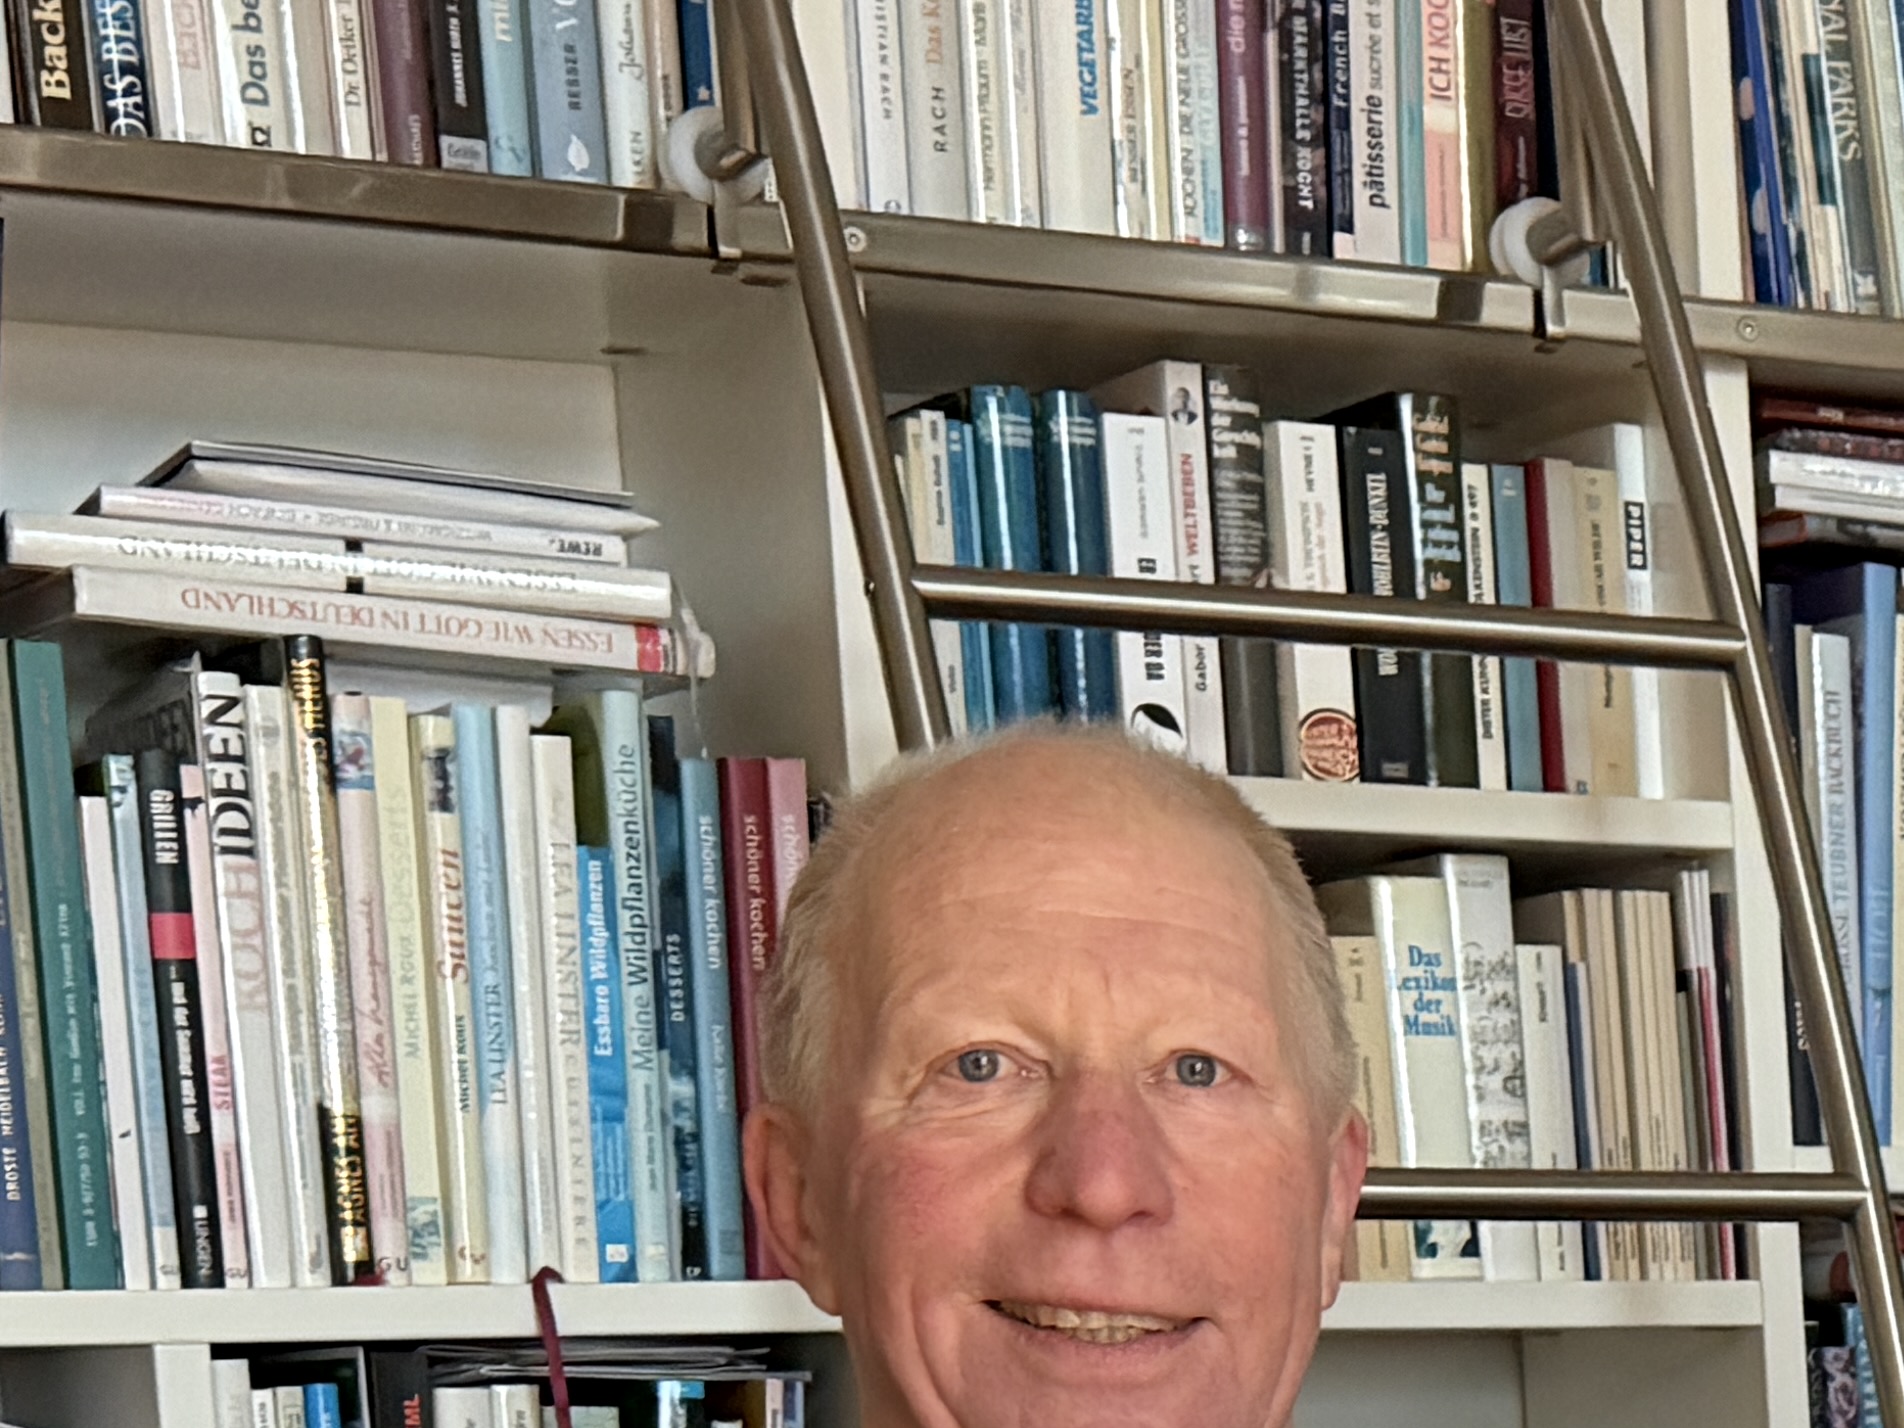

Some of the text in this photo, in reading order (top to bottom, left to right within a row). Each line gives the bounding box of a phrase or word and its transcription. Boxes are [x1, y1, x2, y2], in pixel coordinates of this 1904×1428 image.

[239, 45, 271, 107] Das
[1427, 56, 1454, 101] ICH
[930, 86, 950, 154] RACH
[1828, 60, 1861, 160] PARKS
[1359, 93, 1392, 210] pâtisserie
[1625, 504, 1645, 569] PIPER
[180, 587, 374, 629] DEUTSCHLAND
[380, 610, 410, 635] IN
[416, 612, 483, 640] GOTT
[541, 627, 613, 653] ESSEN
[1195, 643, 1208, 692] Gabor
[150, 790, 179, 865] GRILLEN
[549, 841, 573, 898] LEA
[697, 814, 723, 970] schöner kochen
[742, 814, 767, 971] schöner kochen
[584, 859, 612, 980] Wildpflanzen
[615, 742, 655, 1073] Meine Wildpflanzenküche
[551, 909, 581, 1048] LINSTER
[665, 932, 687, 1023] DESSERTS
[1406, 944, 1442, 970] Das
[482, 982, 509, 1104] LEA LINSTER
[1401, 1015, 1456, 1039] Musik
[209, 1053, 231, 1112] STEAK
